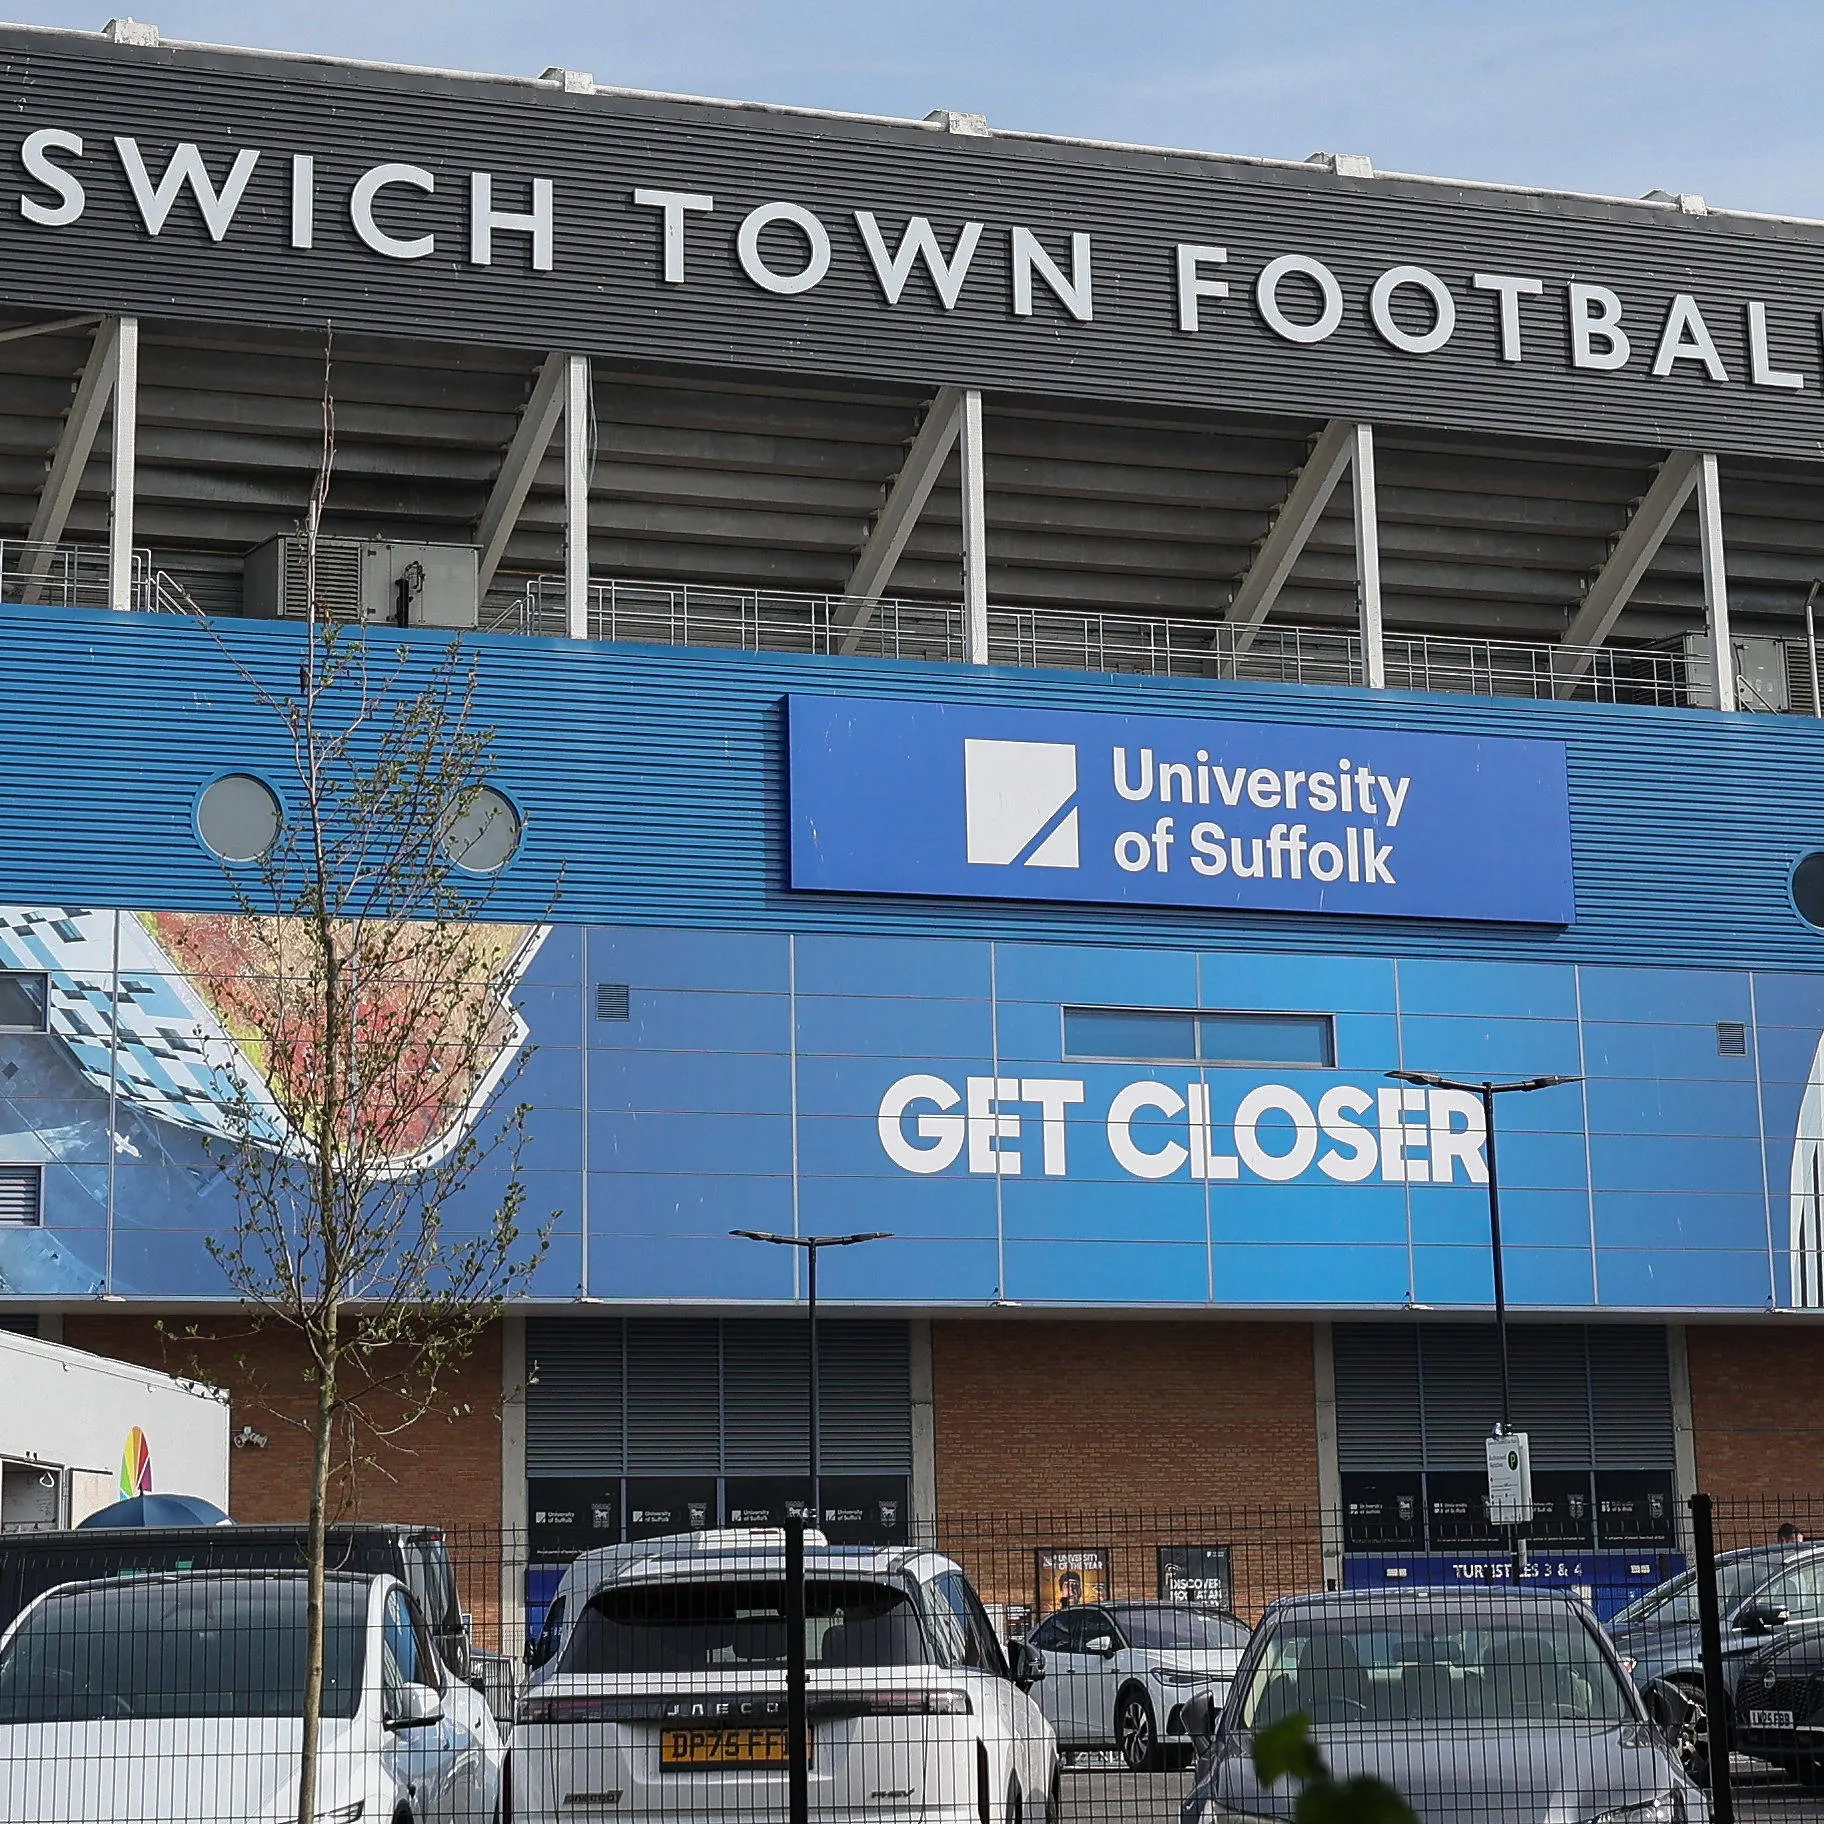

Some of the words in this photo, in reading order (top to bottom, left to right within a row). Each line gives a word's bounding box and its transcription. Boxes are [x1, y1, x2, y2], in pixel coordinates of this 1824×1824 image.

[633, 187, 1093, 323] TOWN
[1113, 745, 1410, 828] University
[1114, 816, 1174, 874] of
[1190, 821, 1396, 885] Suffolk
[878, 1074, 1084, 1176] GET
[1107, 1081, 1489, 1184] CLOSER
[672, 1731, 740, 1758] DP75
